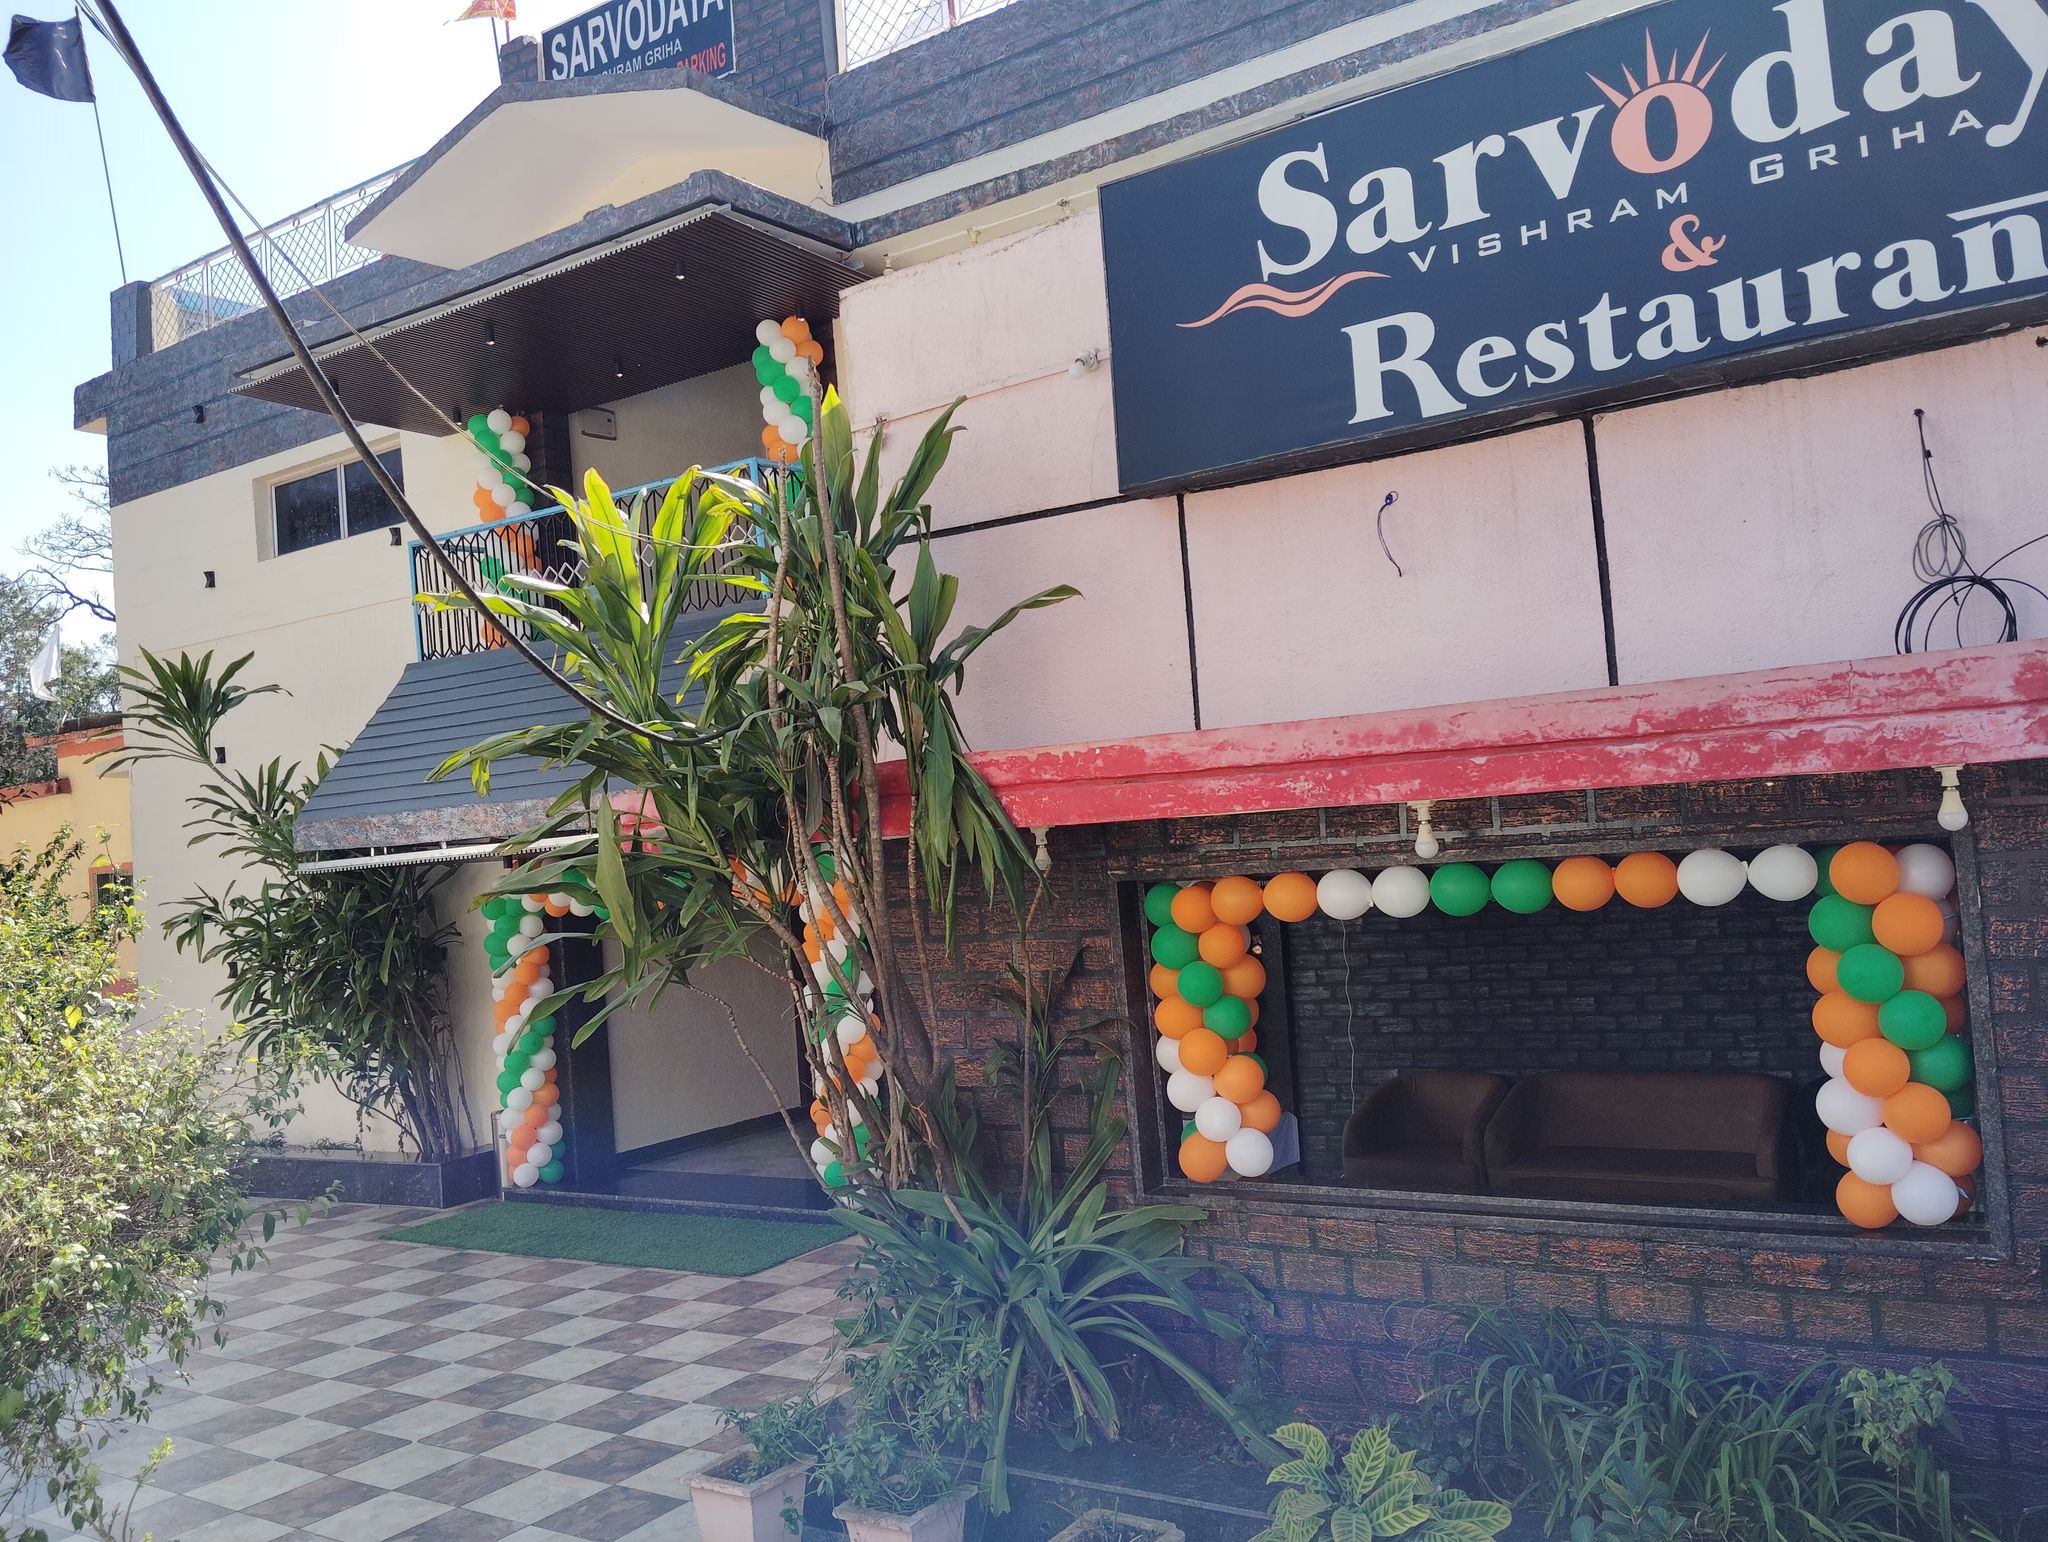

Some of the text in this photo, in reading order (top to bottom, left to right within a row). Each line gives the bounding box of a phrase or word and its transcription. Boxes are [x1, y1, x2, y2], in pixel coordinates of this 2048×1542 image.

[645, 38, 682, 66] GRIHA
[1408, 109, 1983, 272] VISHRAM GRIHA
[1661, 213, 1727, 272] &
[1340, 190, 2048, 425] Restauran
